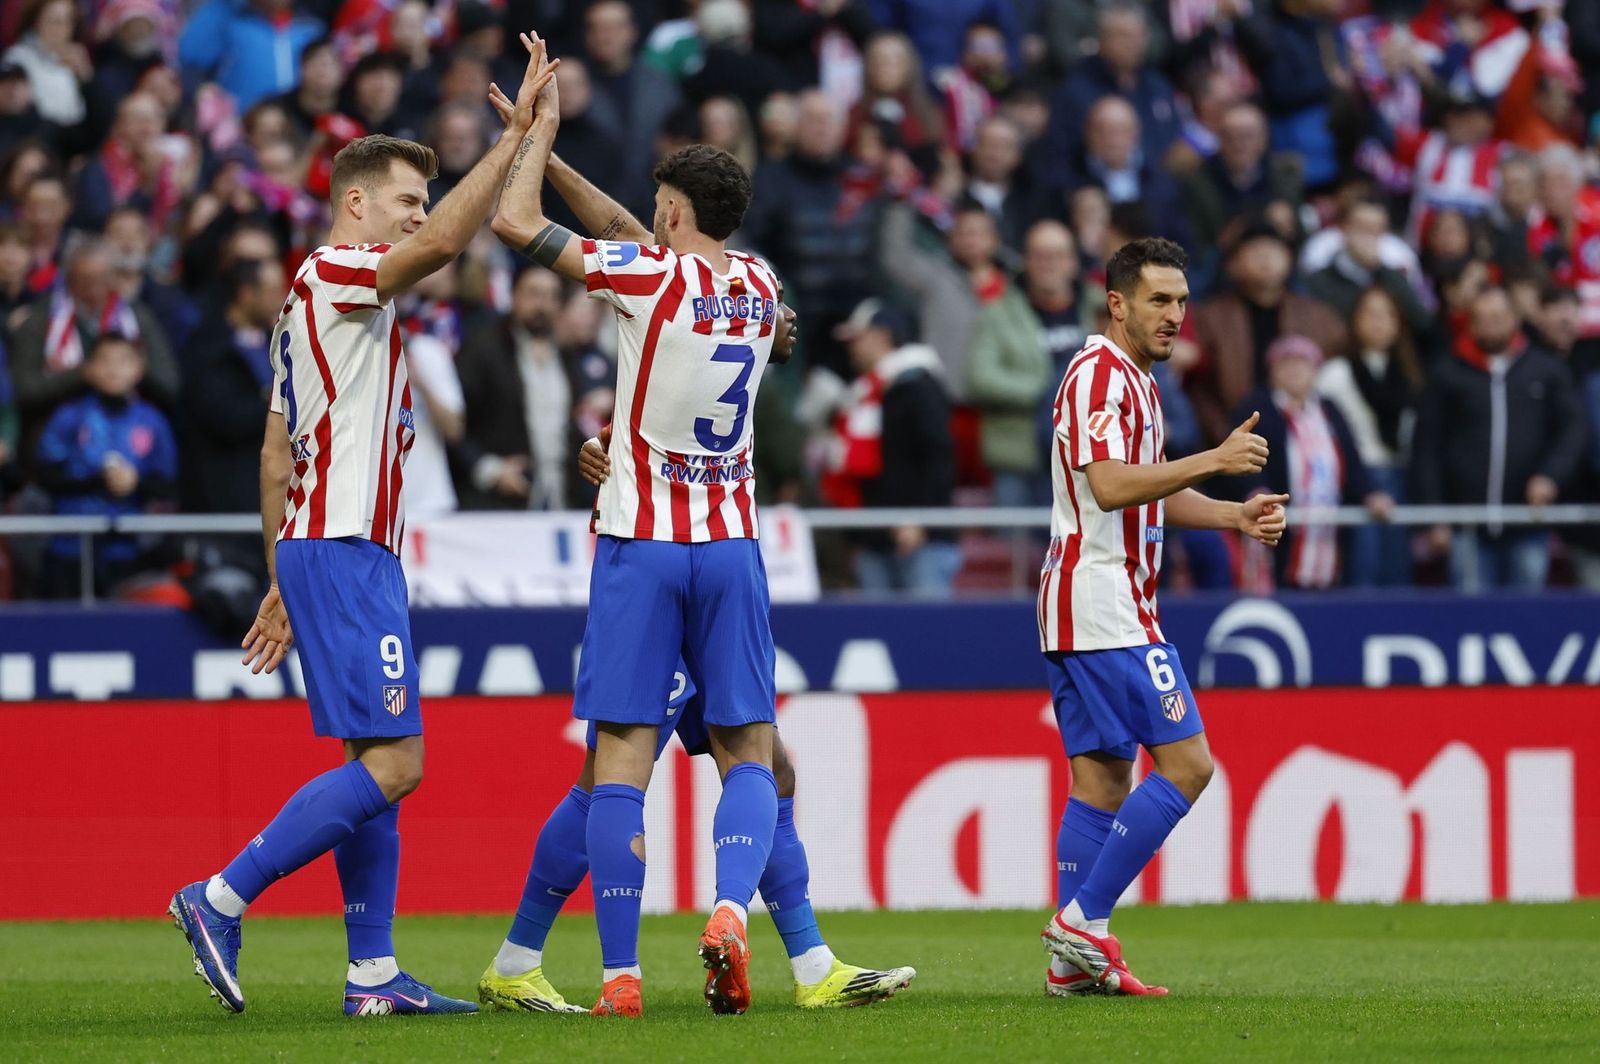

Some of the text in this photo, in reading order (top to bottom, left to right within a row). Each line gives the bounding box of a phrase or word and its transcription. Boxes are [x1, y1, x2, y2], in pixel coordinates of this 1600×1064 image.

[693, 343, 756, 453] 3
[380, 634, 405, 680] 9
[1145, 648, 1176, 692] 6
